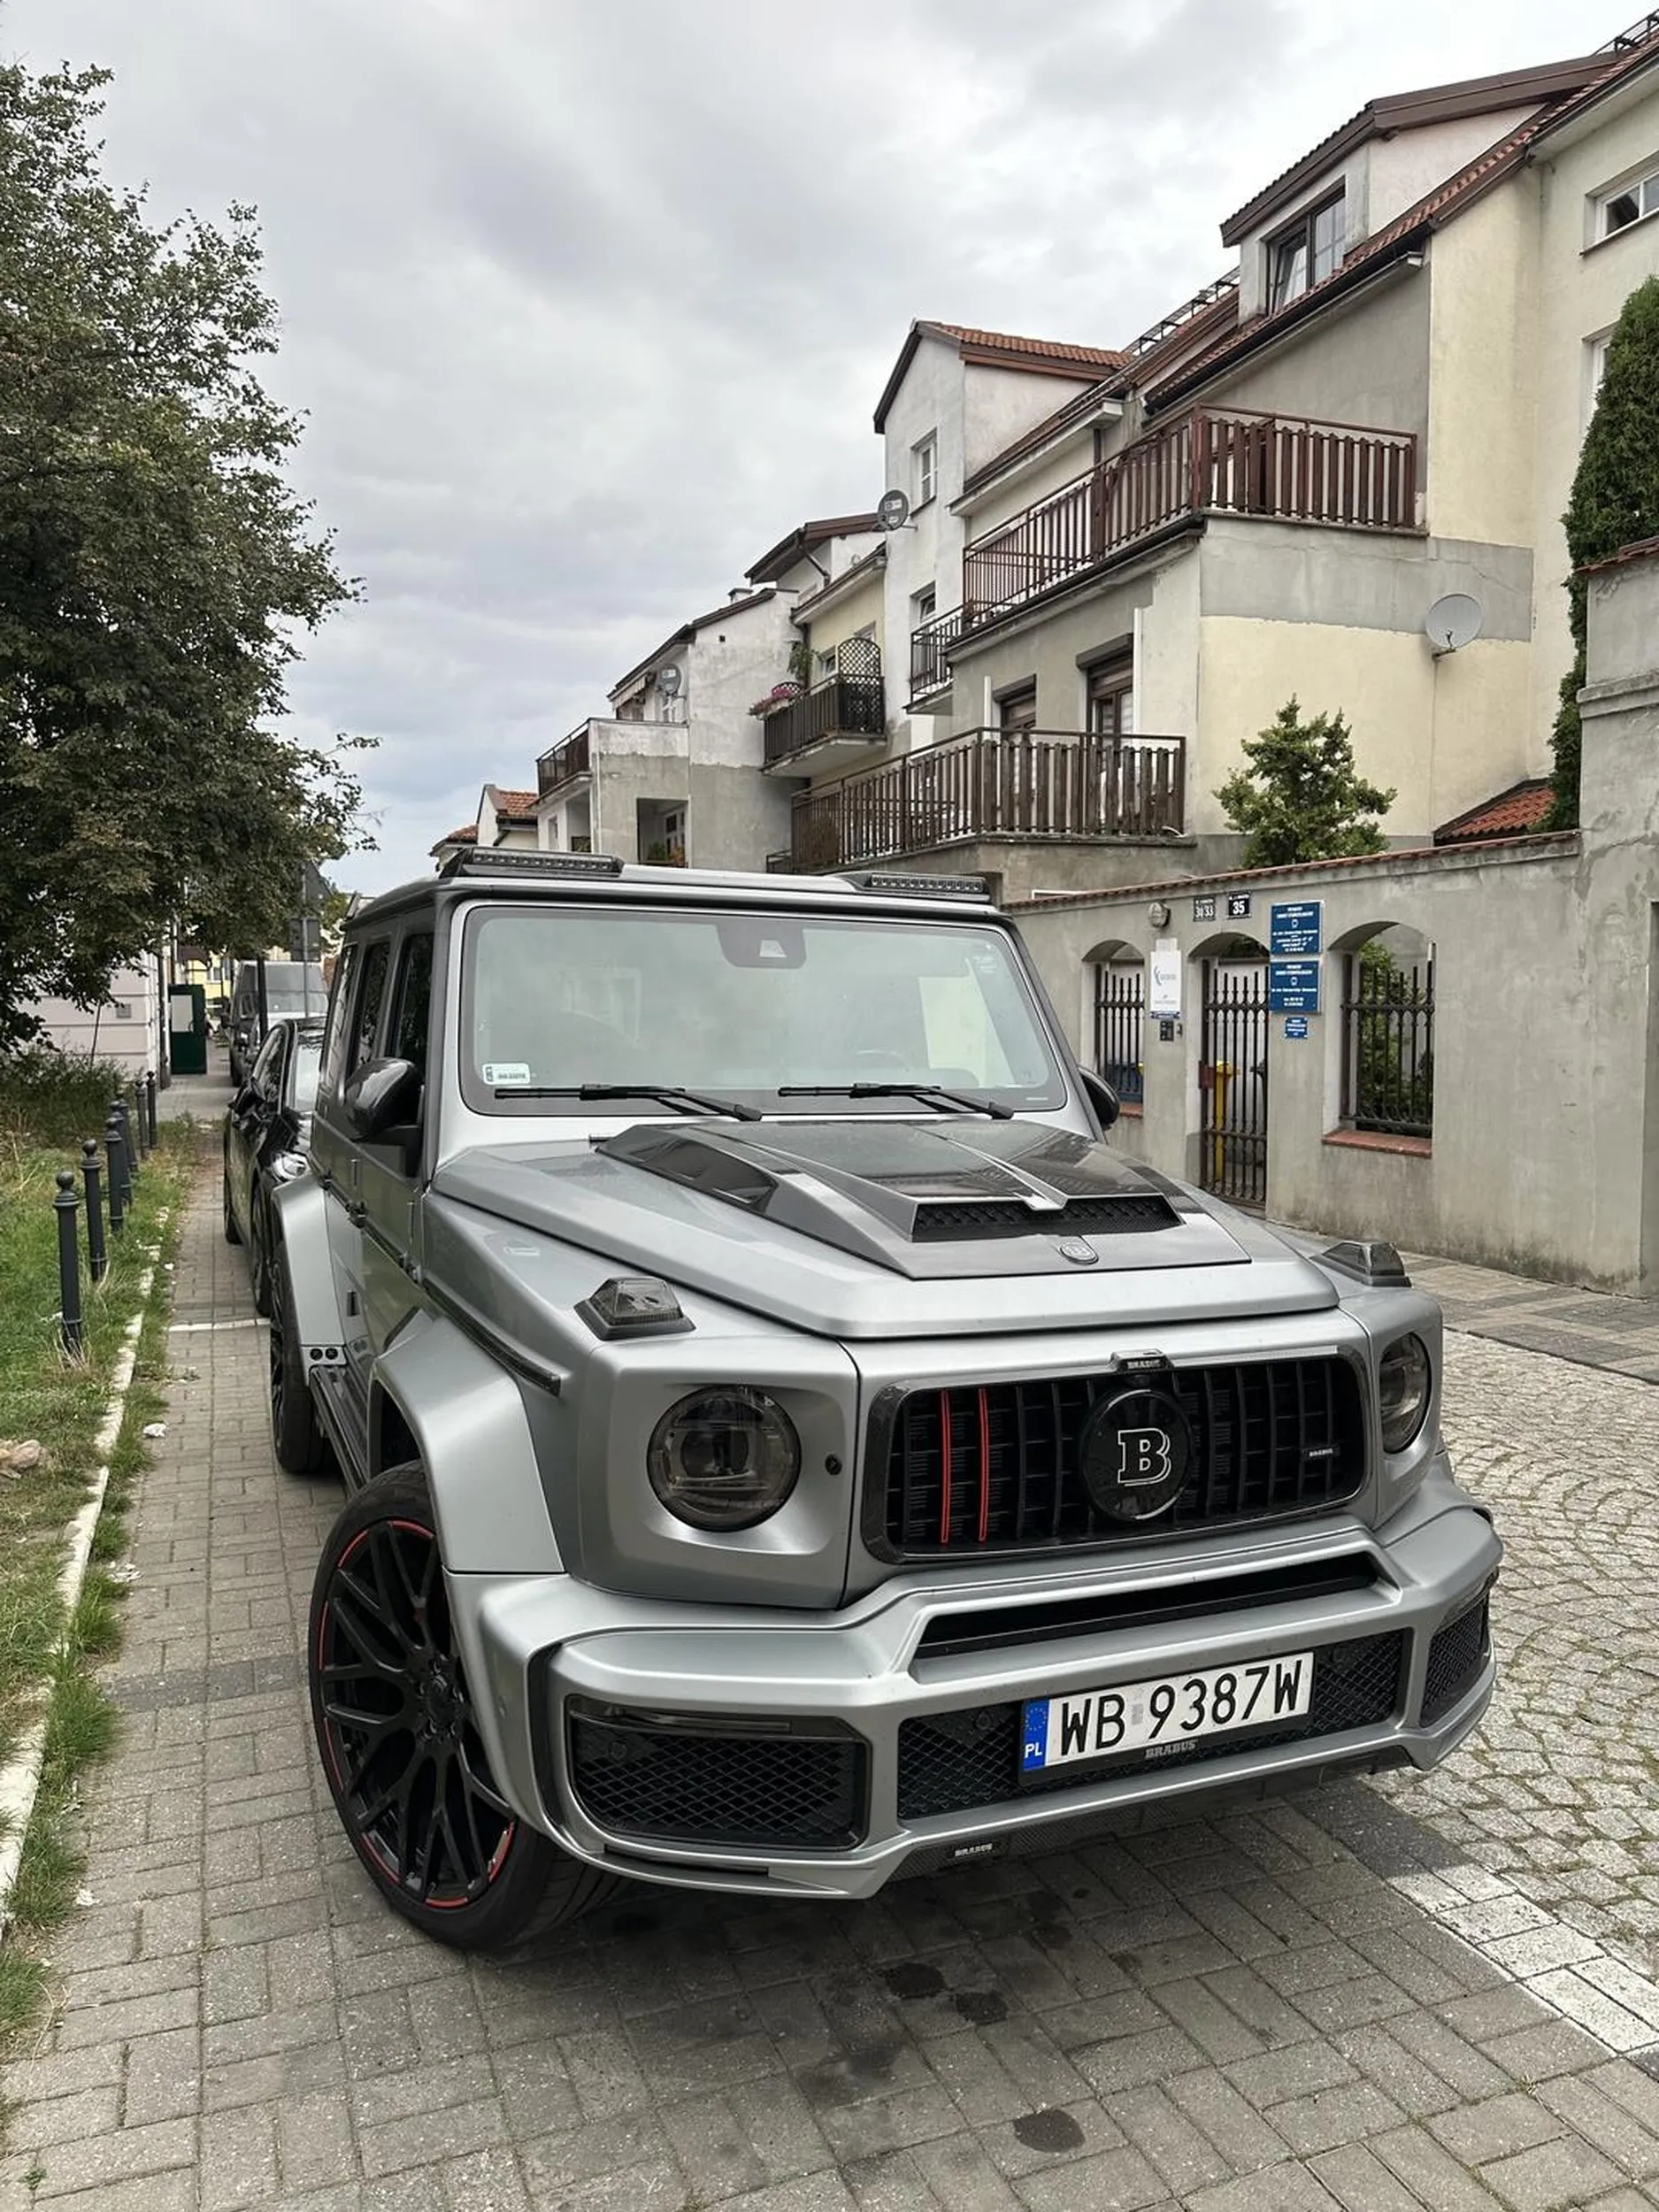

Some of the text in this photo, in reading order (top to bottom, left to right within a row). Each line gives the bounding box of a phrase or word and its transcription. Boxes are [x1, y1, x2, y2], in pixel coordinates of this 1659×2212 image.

[1233, 900, 1246, 915] 35
[1118, 1427, 1171, 1486] B
[1061, 1660, 1302, 1756] WB 9387W
[1024, 1743, 1043, 1758] PL
[1145, 1739, 1199, 1759] BRABUS
